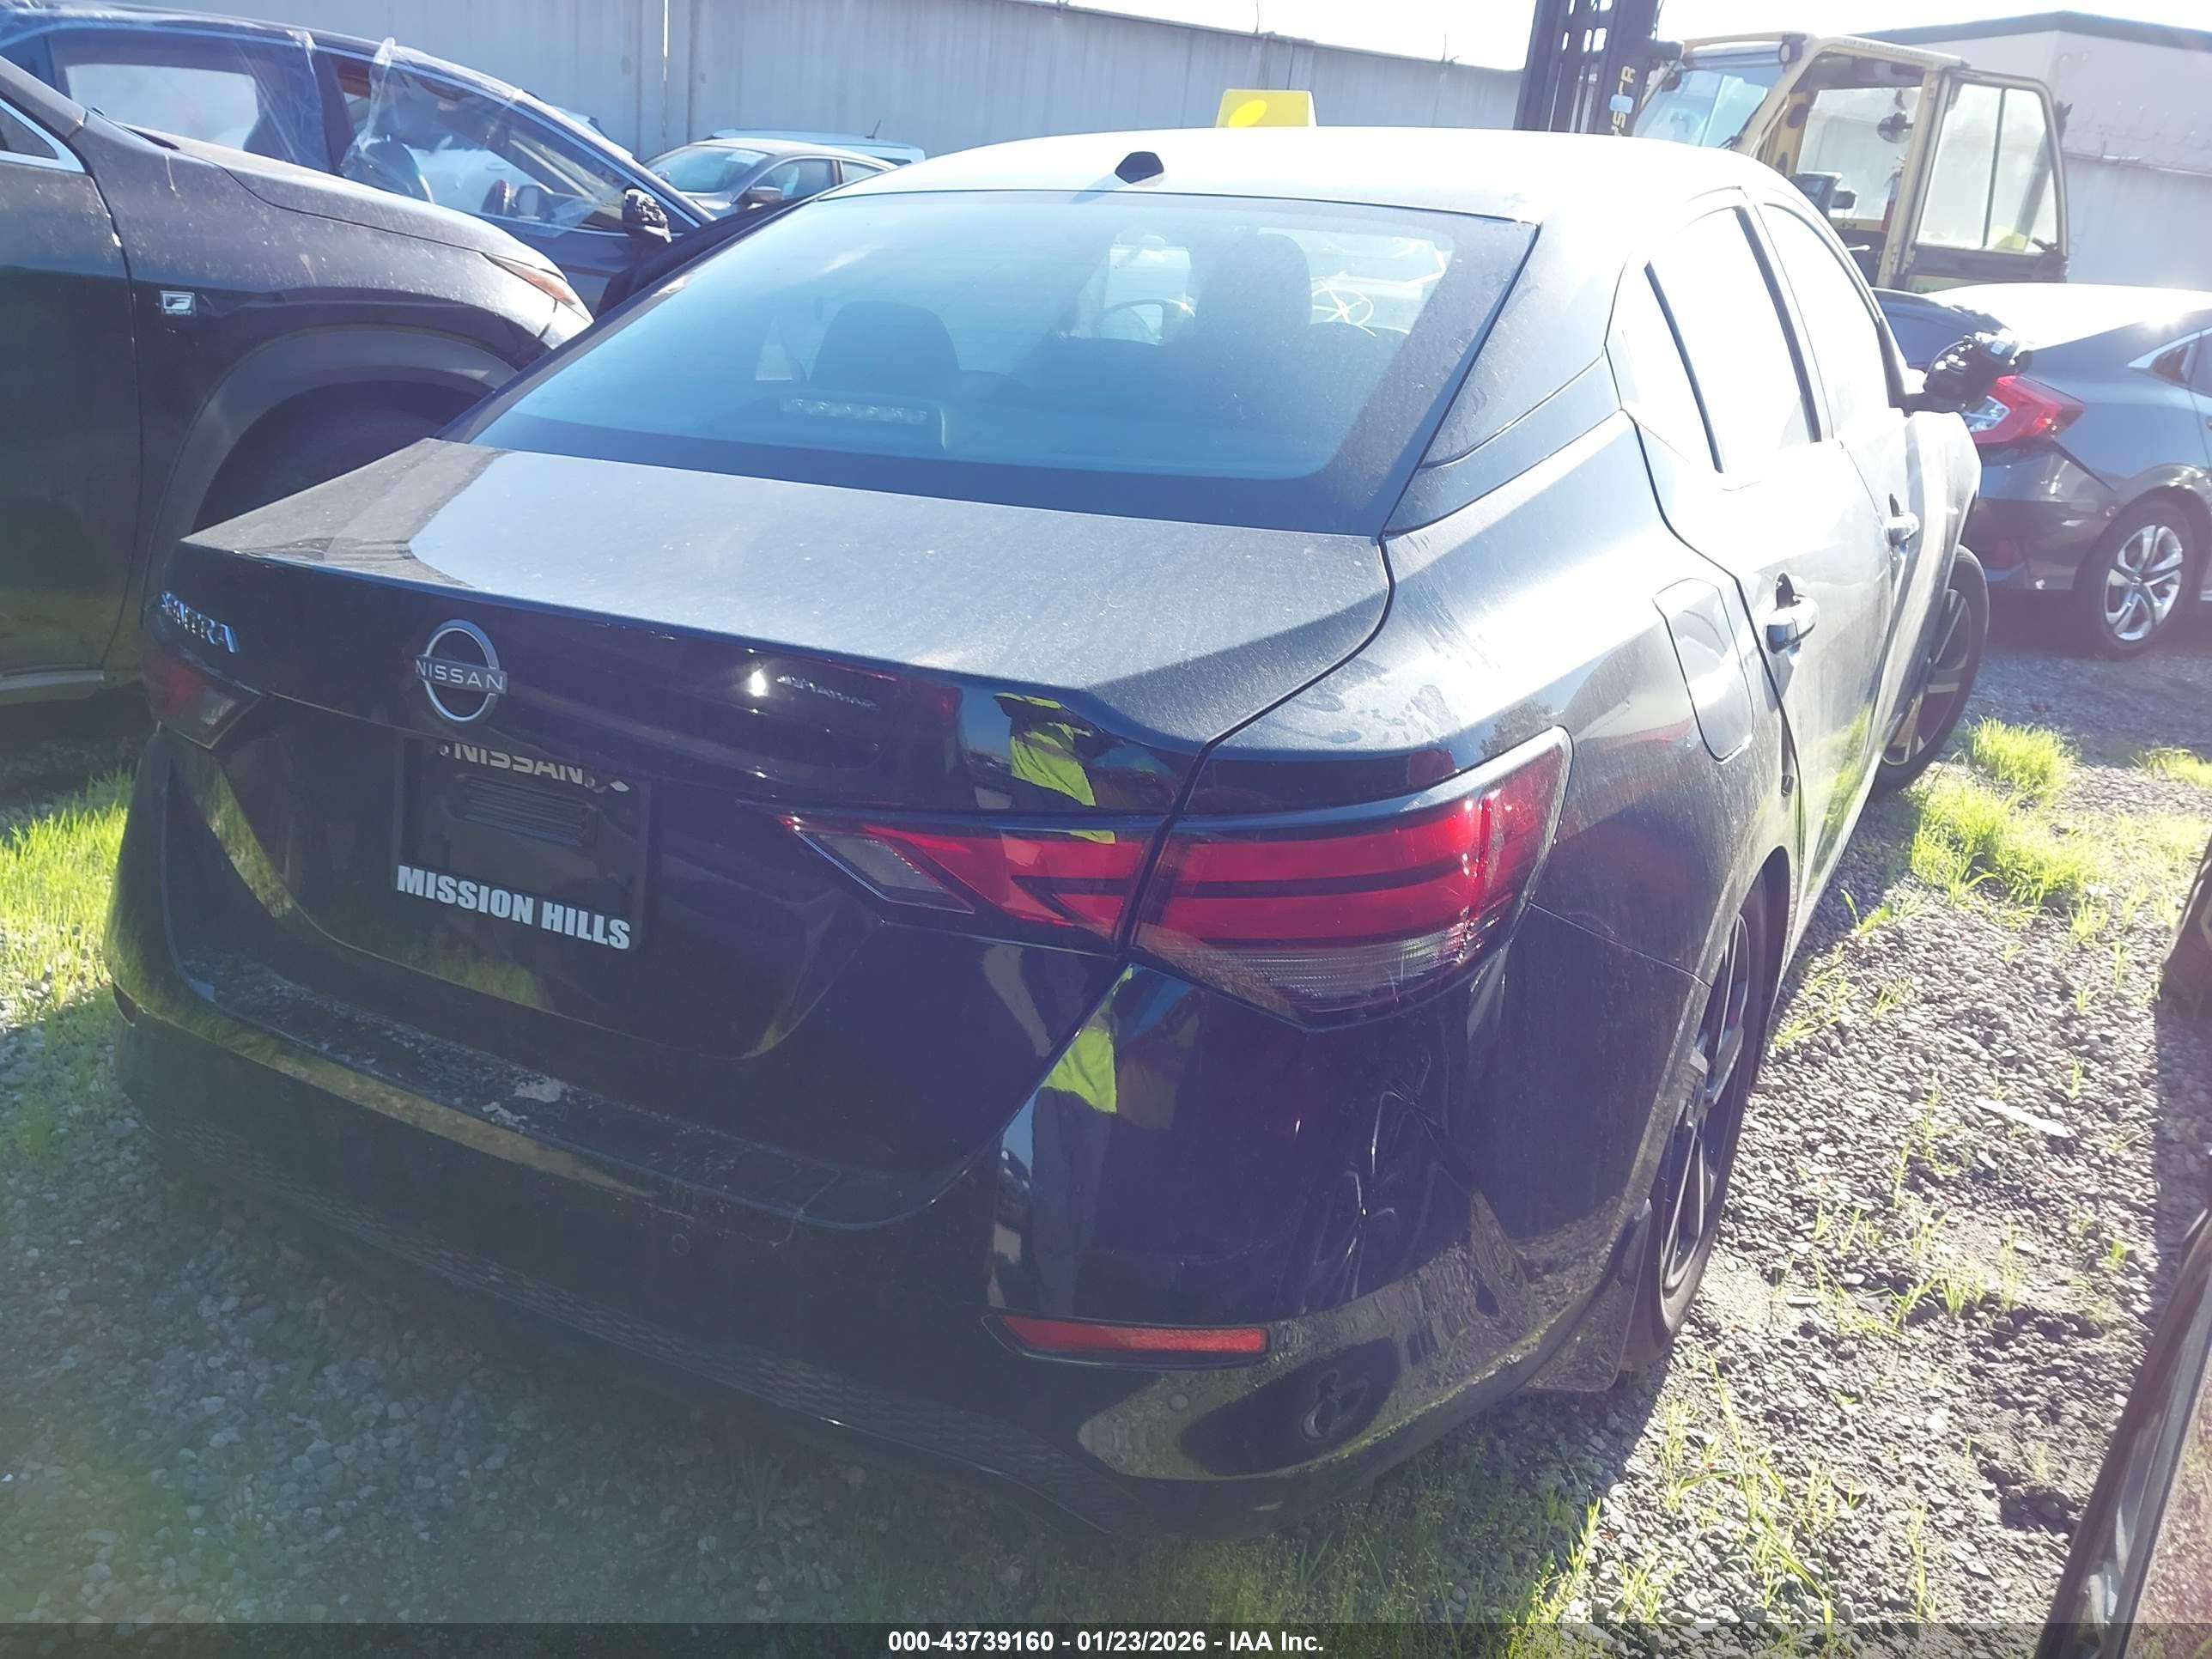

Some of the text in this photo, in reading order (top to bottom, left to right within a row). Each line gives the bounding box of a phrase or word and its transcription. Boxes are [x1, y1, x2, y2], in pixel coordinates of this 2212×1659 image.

[416, 659, 503, 690] NISSAN
[454, 742, 583, 785] NISSAN
[397, 865, 630, 950] MISSION HILLS
